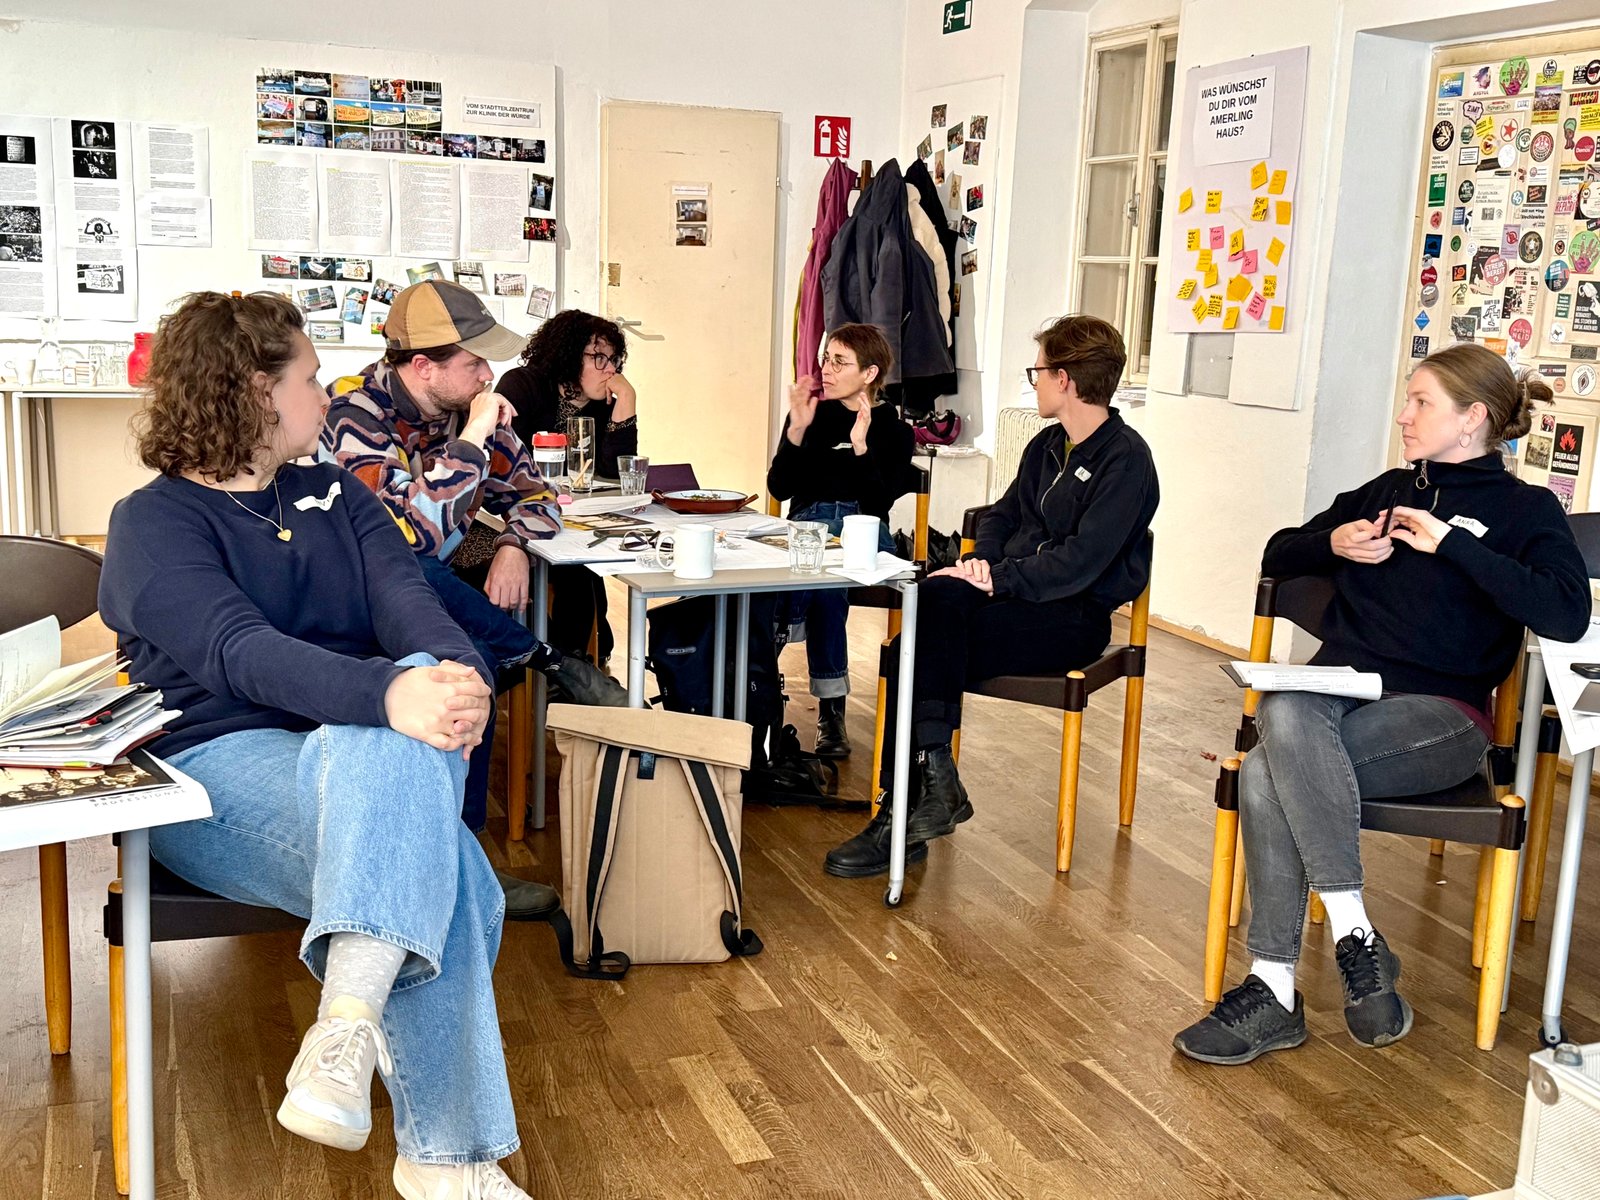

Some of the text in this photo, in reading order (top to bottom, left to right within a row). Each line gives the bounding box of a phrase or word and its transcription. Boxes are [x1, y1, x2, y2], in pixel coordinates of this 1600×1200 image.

[1201, 77, 1267, 99] WAS WÜNSCHST
[1208, 94, 1257, 111] DU DIR VOM
[1210, 109, 1253, 125] AMERLING
[1216, 125, 1244, 139] HAUS?
[1415, 336, 1428, 345] FAT
[1414, 345, 1427, 353] FOX
[94, 789, 186, 807] PROFESSIONAL
